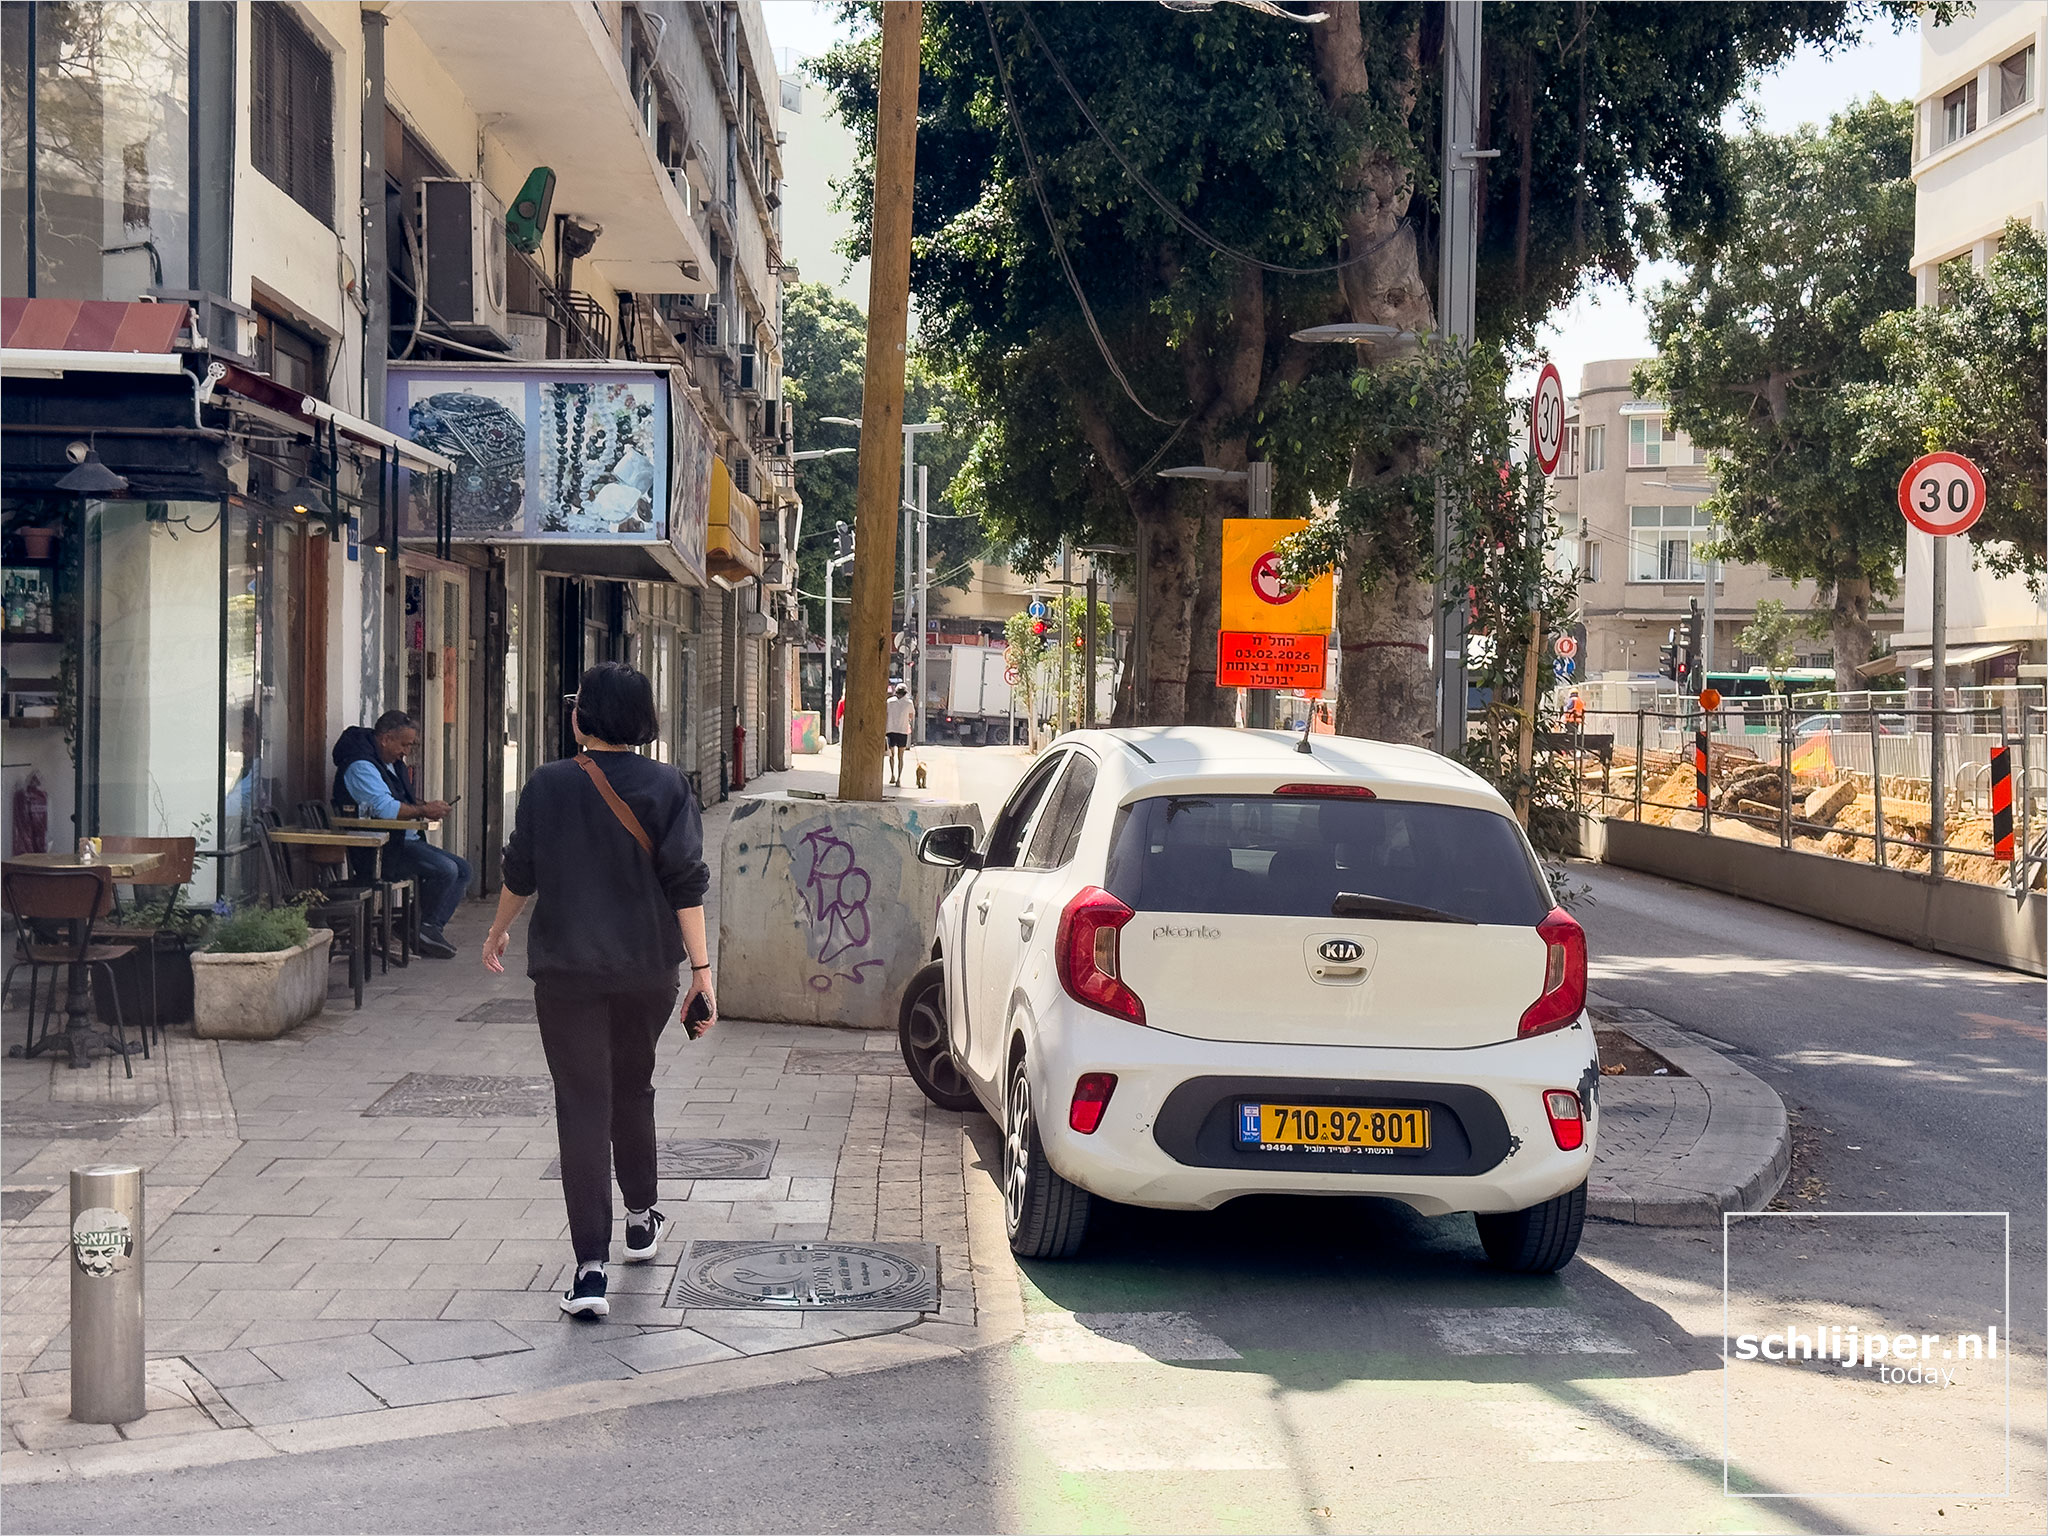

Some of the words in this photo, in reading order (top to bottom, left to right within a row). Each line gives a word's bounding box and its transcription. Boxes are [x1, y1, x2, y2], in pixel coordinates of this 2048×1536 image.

[1540, 392, 1560, 447] 30
[1919, 479, 1969, 513] 30
[1268, 635, 1295, 647] החל
[1235, 649, 1311, 660] 03.02.2026
[1225, 661, 1269, 672] בצומת
[1276, 663, 1319, 673] הפניות
[1250, 674, 1294, 686] יבוטלו
[1152, 925, 1222, 941] picanto
[1325, 943, 1358, 959] KIA
[1246, 1116, 1258, 1132] IL
